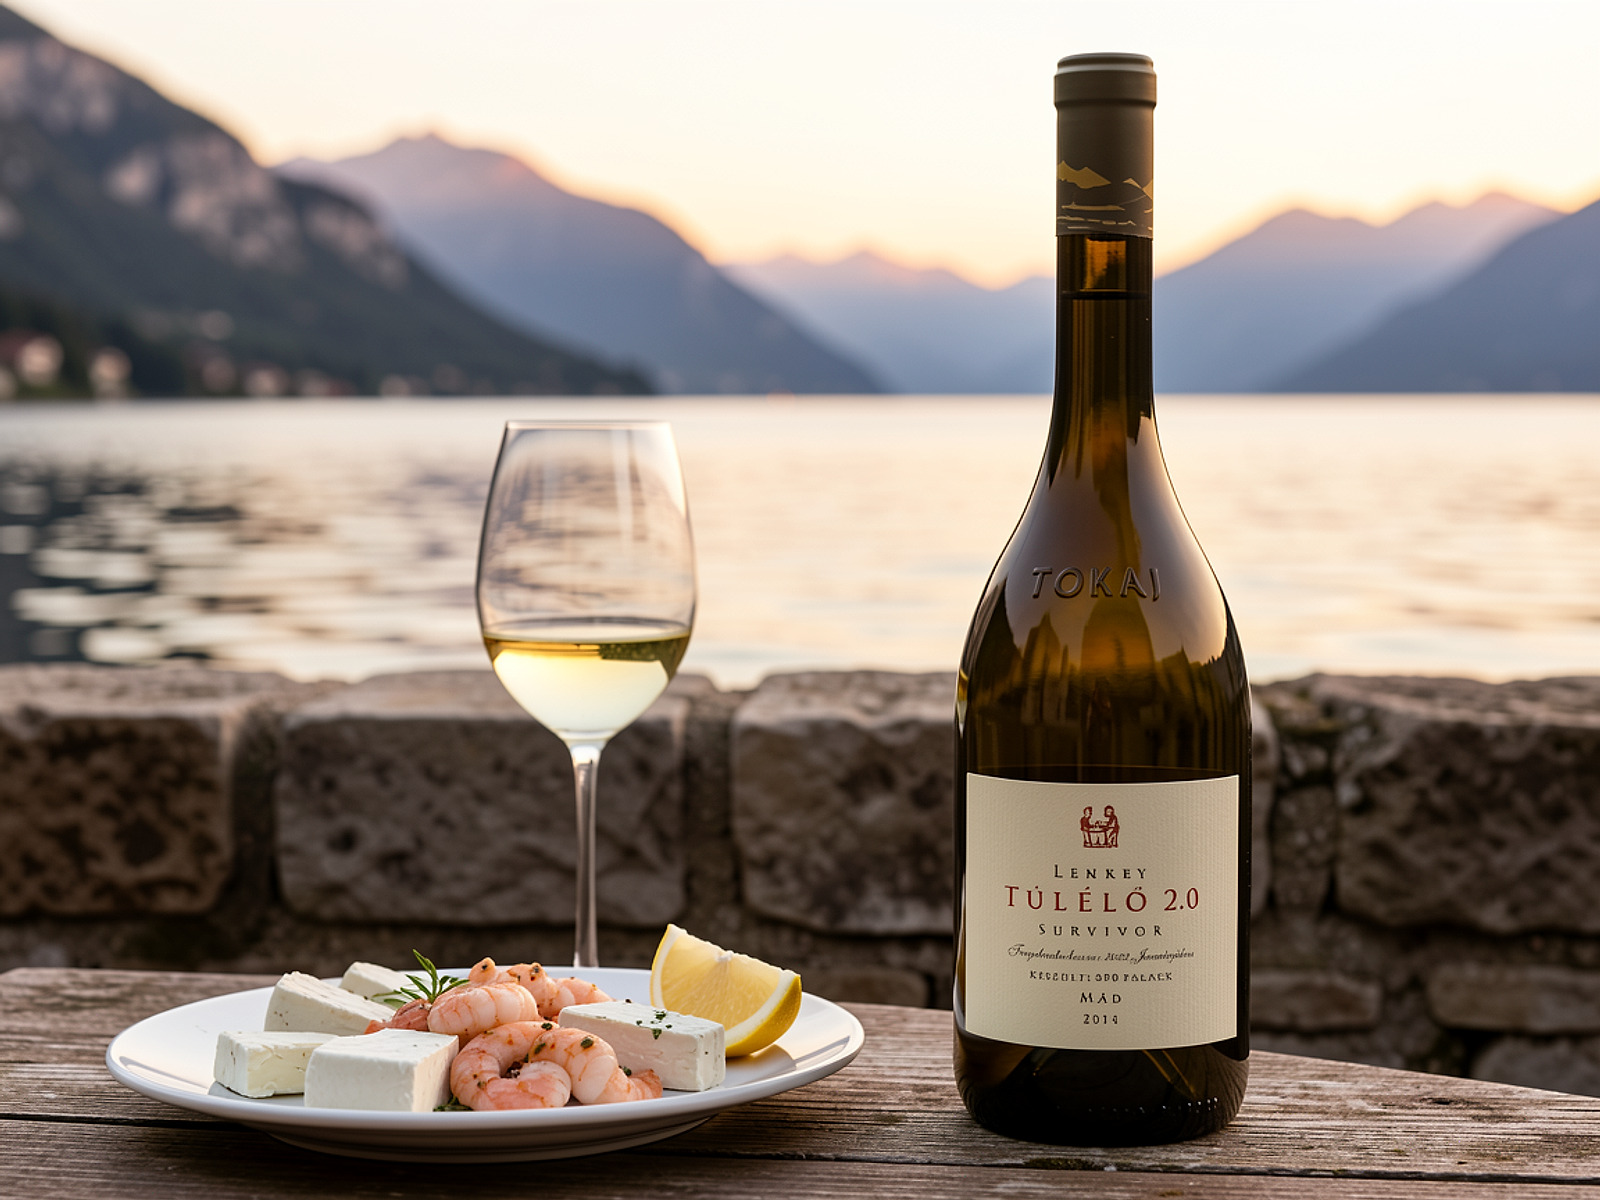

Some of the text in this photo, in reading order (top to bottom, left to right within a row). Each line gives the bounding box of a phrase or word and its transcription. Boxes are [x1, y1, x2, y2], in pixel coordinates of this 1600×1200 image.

[1032, 567, 1161, 601] TOKAJ
[1054, 864, 1147, 879] LENKEY
[1164, 888, 1199, 911] 2.0
[1038, 924, 1162, 937] SURVIVOR
